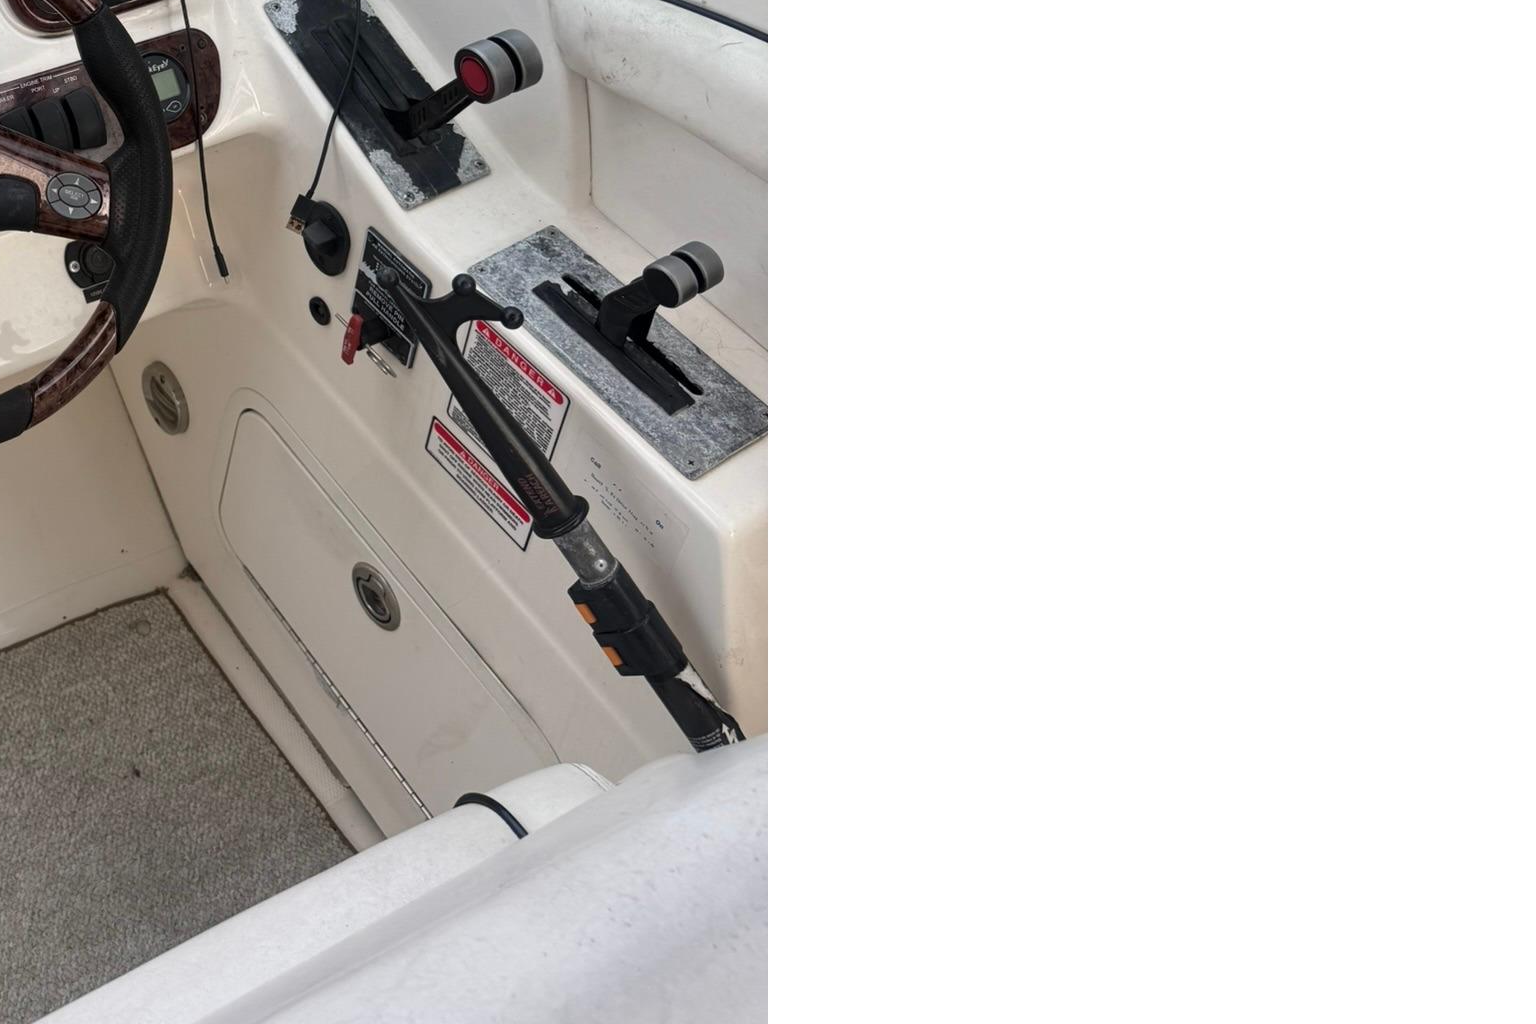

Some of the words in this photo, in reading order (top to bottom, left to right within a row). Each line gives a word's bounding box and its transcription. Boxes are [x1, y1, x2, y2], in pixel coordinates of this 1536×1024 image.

[20, 78, 40, 89] ENGINE
[39, 74, 53, 83] TRIM
[30, 85, 45, 94] PORT
[366, 290, 381, 308] PULL
[380, 304, 405, 332] HANDLE
[369, 286, 394, 314] REMOVE
[495, 337, 545, 388] DANGER
[467, 457, 500, 491] DANGER
